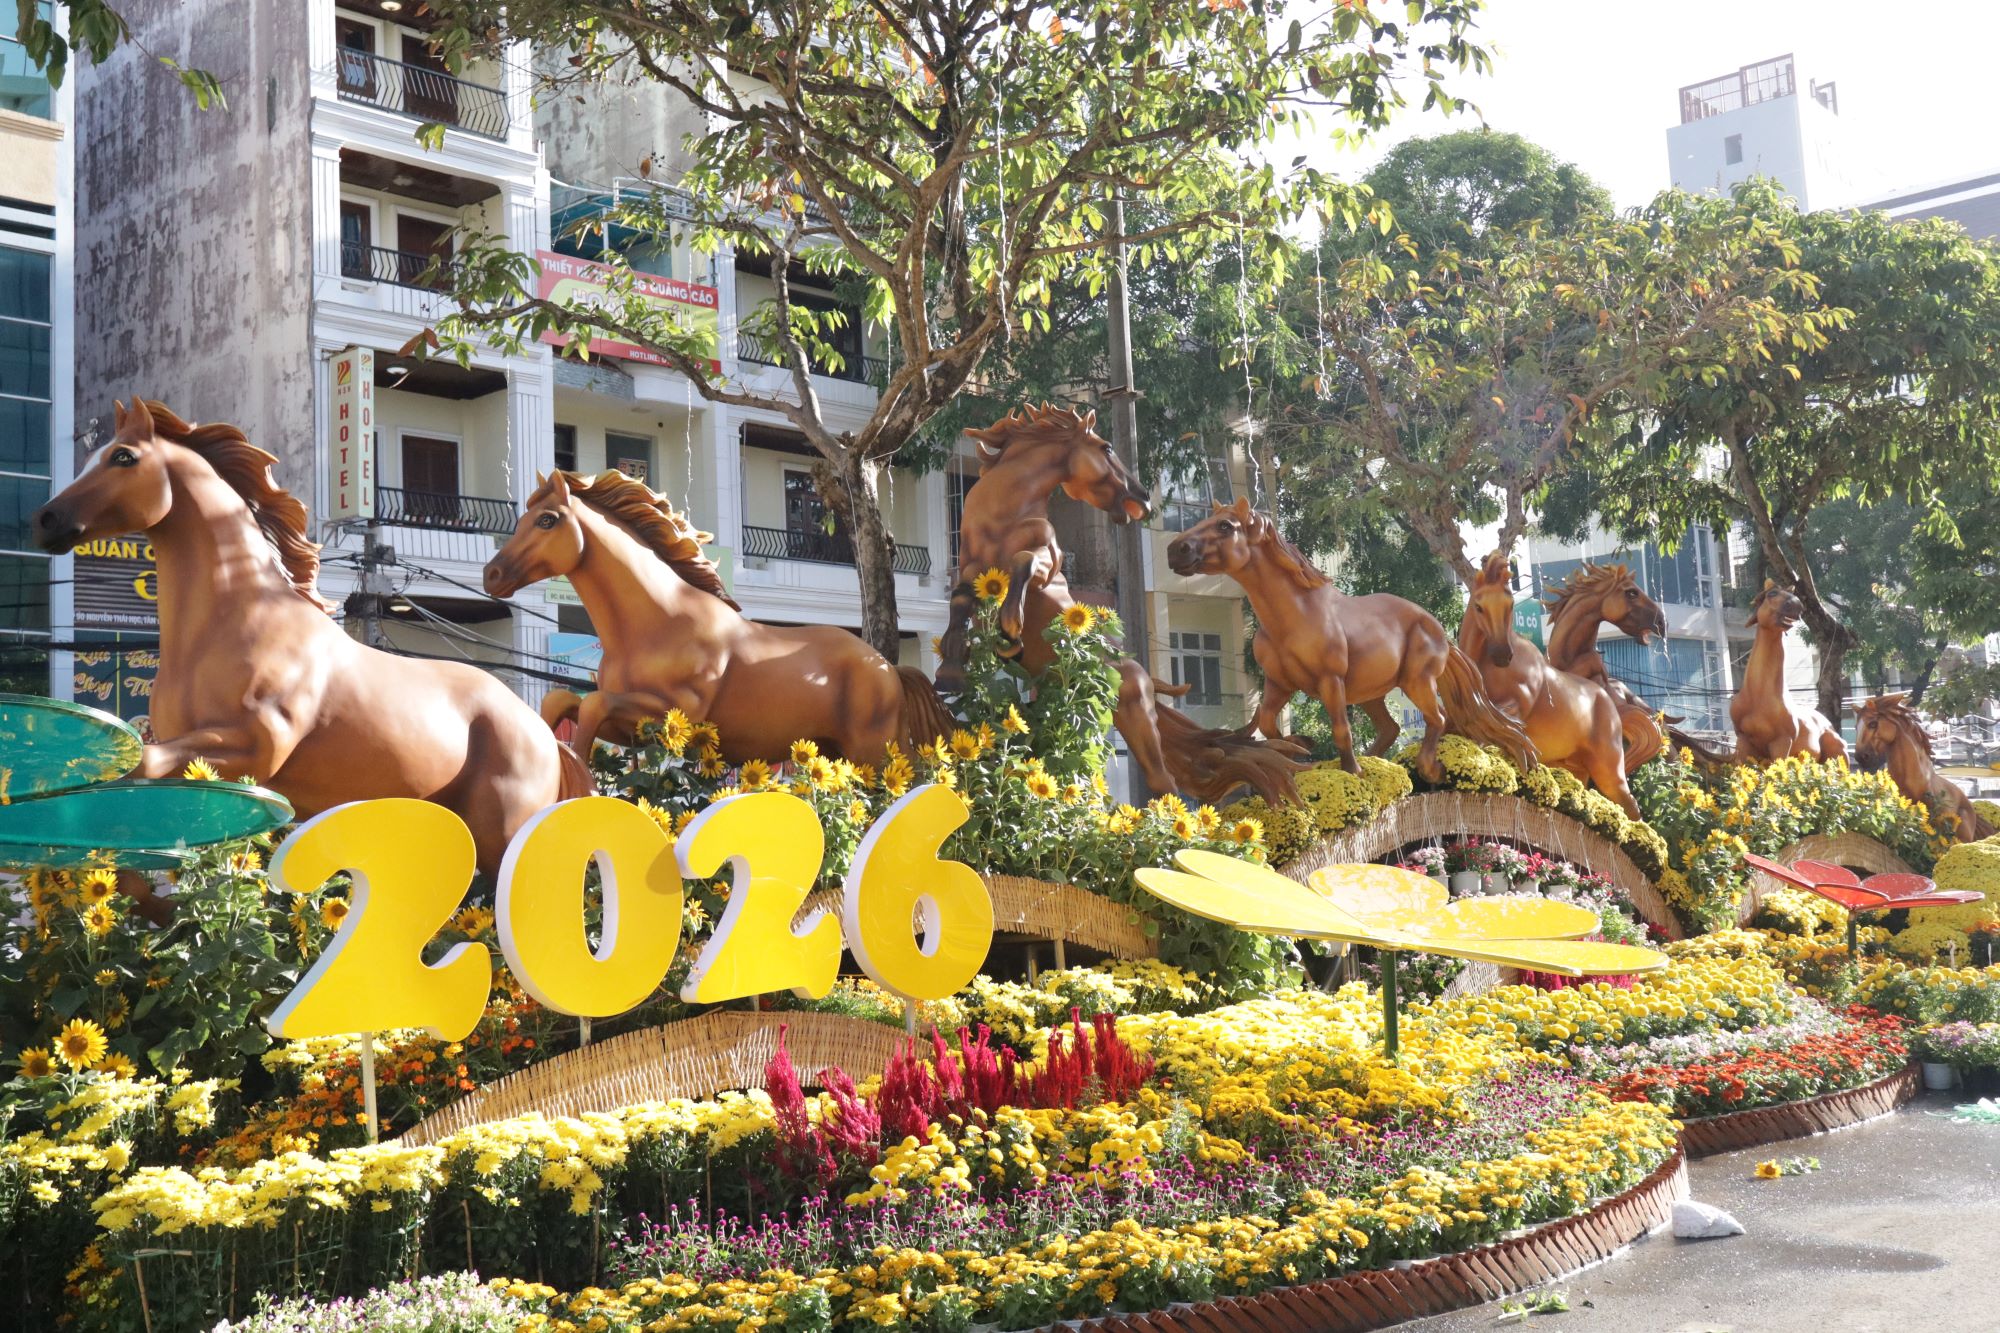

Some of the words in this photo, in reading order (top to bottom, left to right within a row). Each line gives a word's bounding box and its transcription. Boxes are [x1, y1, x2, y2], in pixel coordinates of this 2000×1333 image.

[542, 258, 572, 275] THIẾT
[650, 280, 688, 300] QUẢNG
[691, 289, 713, 305] CÁO
[339, 402, 349, 510] HOTEL
[362, 380, 370, 507] HOTEL
[1515, 611, 1525, 627] là
[1526, 612, 1537, 629] có
[268, 784, 994, 1043] 2026
